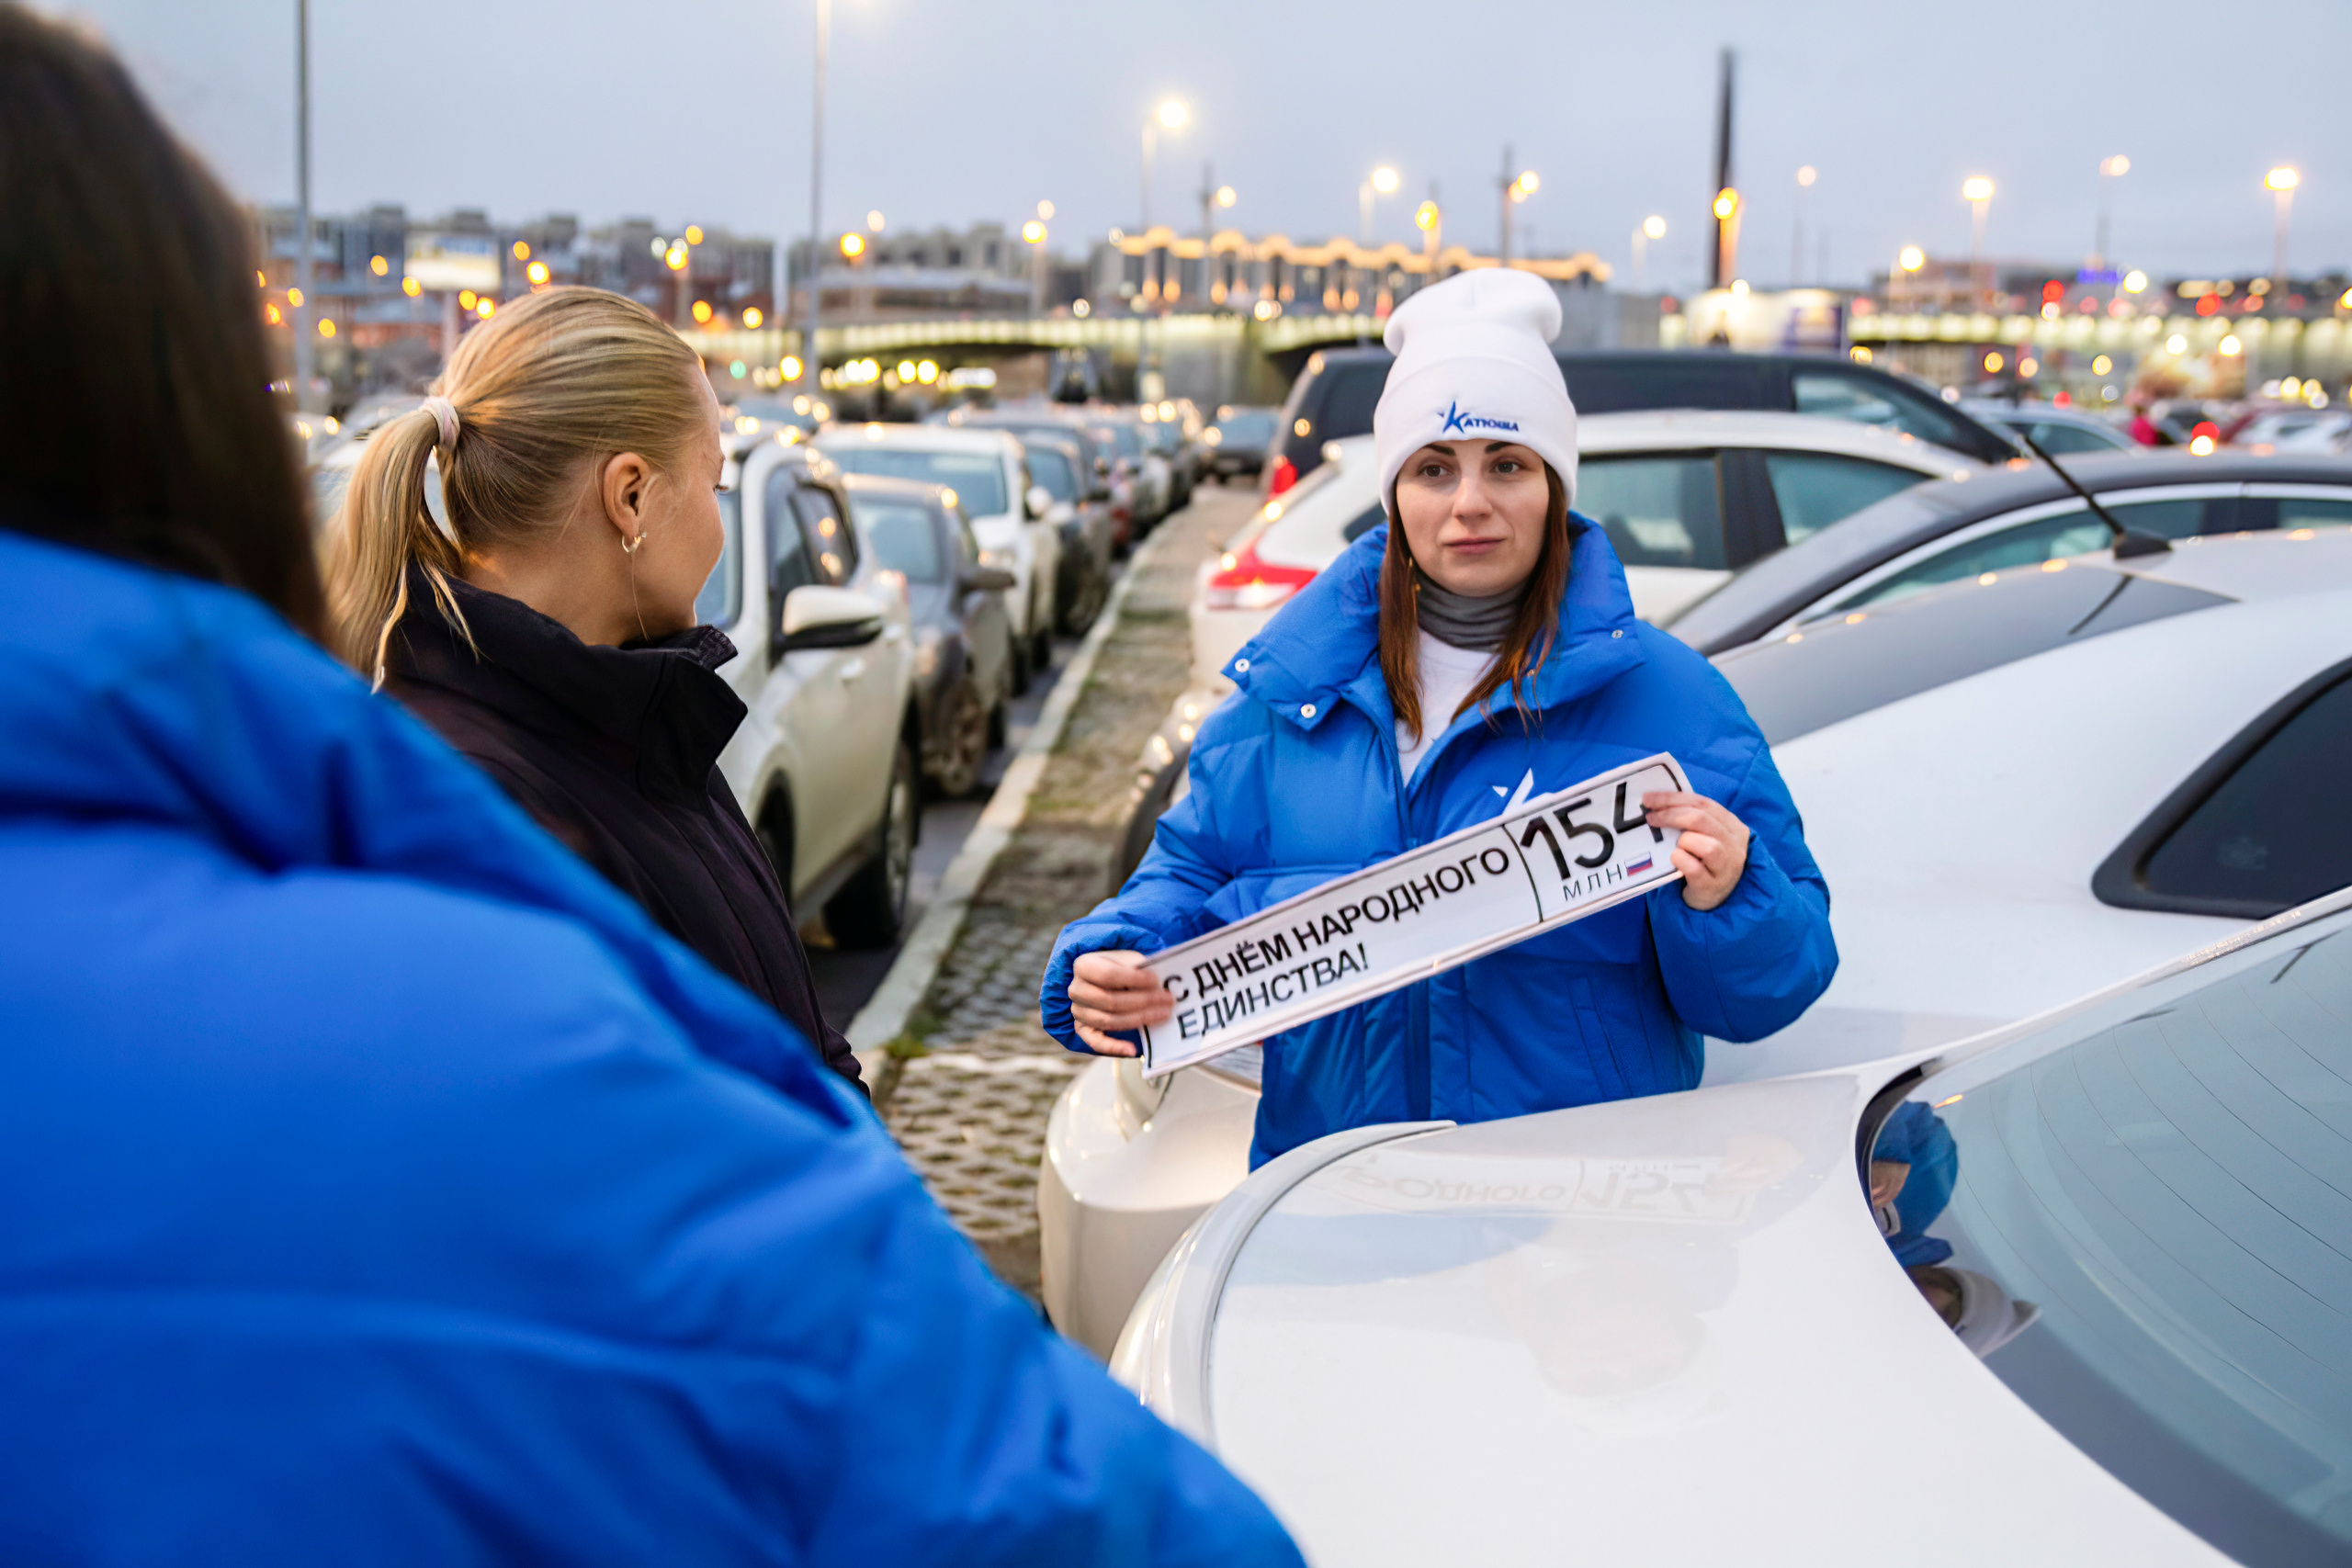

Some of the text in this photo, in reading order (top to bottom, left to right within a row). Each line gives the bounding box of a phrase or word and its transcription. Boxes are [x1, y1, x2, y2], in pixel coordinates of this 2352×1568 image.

[1520, 781, 1664, 881] 154
[1163, 847, 1510, 1002] С ДНЁМ НАРОДНОГО
[1563, 863, 1623, 902] МЛН
[1177, 942, 1369, 1040] ЕДИНСТВА!
